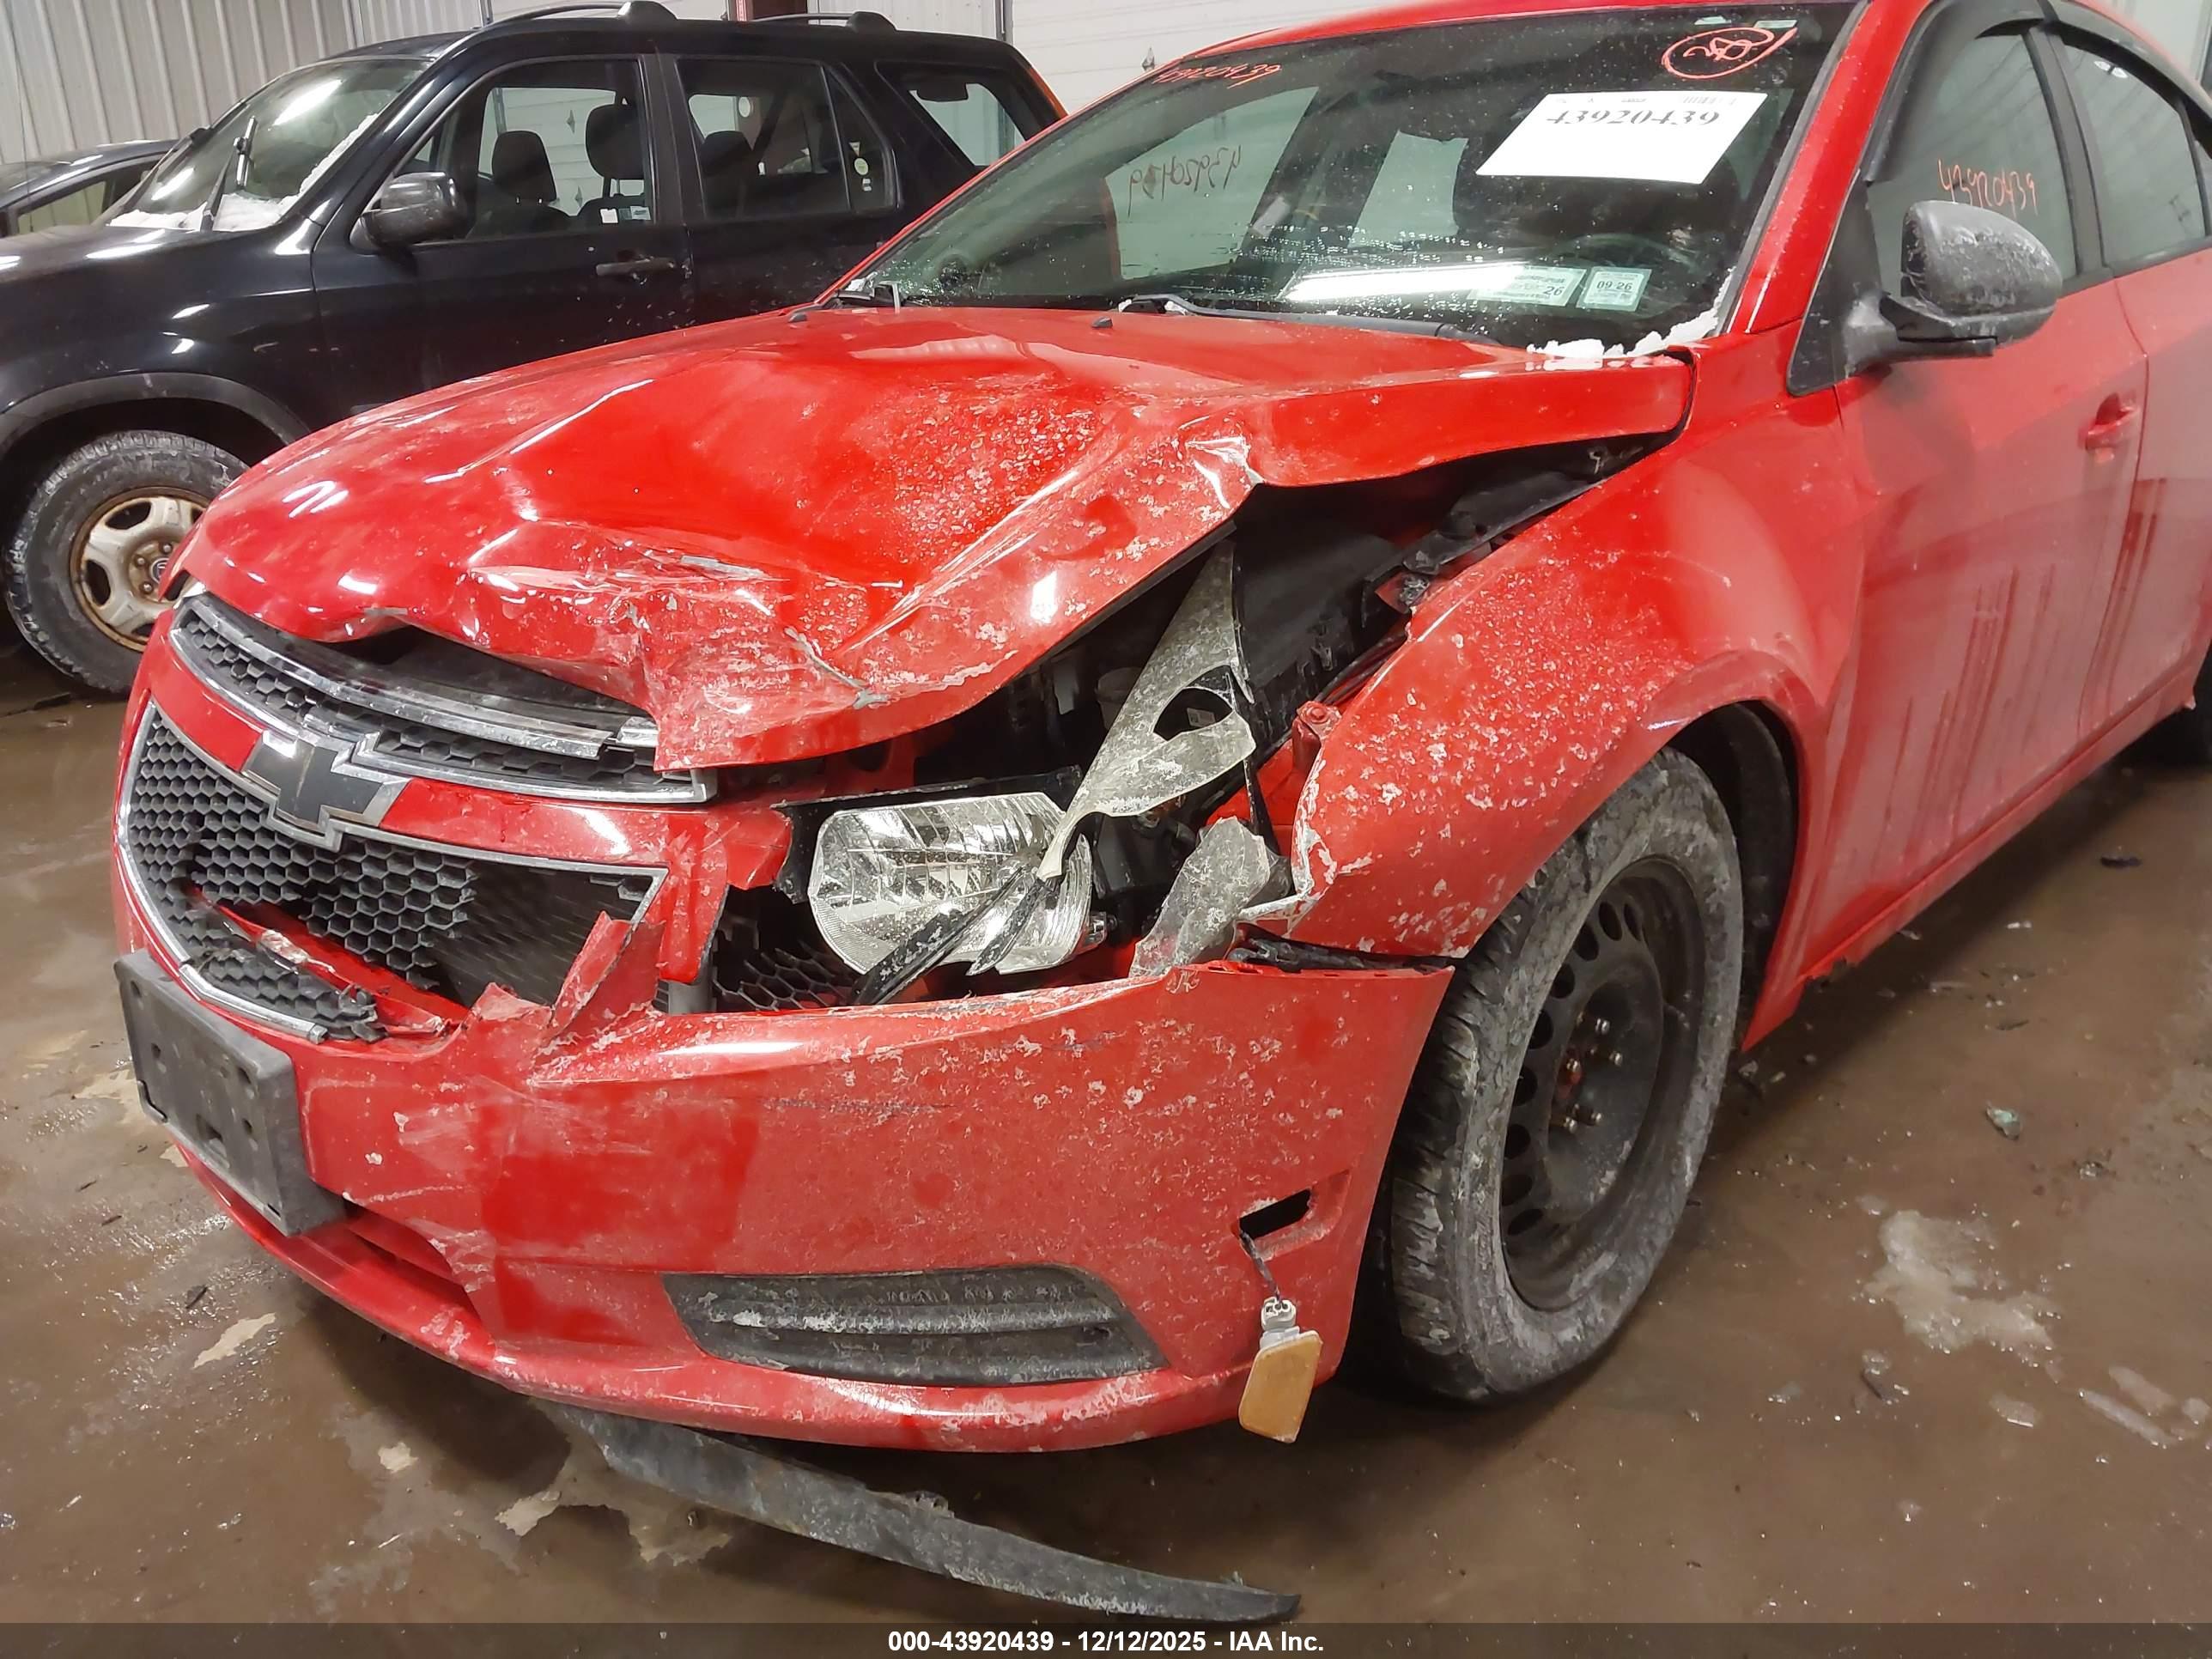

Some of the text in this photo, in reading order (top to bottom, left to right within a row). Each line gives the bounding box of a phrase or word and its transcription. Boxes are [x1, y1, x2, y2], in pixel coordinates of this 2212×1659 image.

[1546, 108, 1721, 126] 43920439
[1542, 285, 1565, 296] 26
[1596, 280, 1633, 291] 09 26
